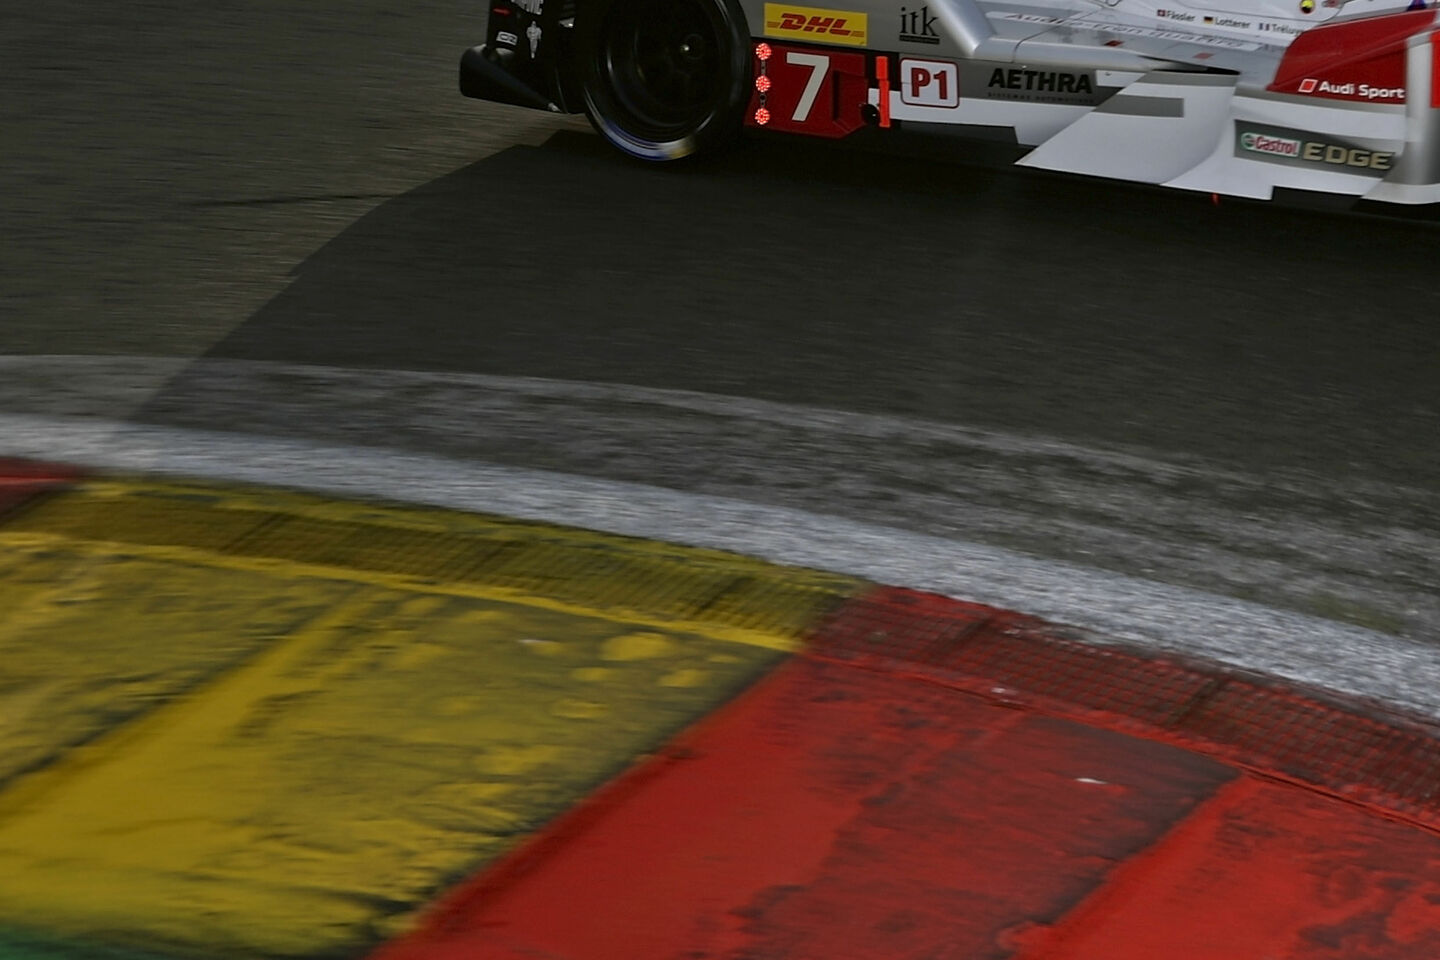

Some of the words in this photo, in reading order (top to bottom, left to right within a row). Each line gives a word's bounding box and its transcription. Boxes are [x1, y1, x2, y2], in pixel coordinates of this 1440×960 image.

[779, 12, 852, 36] DHL
[899, 6, 940, 37] itk
[1215, 17, 1251, 29] Lotterer
[786, 52, 830, 122] 7
[910, 67, 948, 100] P1
[988, 67, 1092, 94] AETHRA
[1318, 80, 1355, 95] Audi
[1358, 84, 1406, 99] Sport
[1255, 135, 1297, 155] Castrol
[1303, 141, 1396, 170] EDGE
